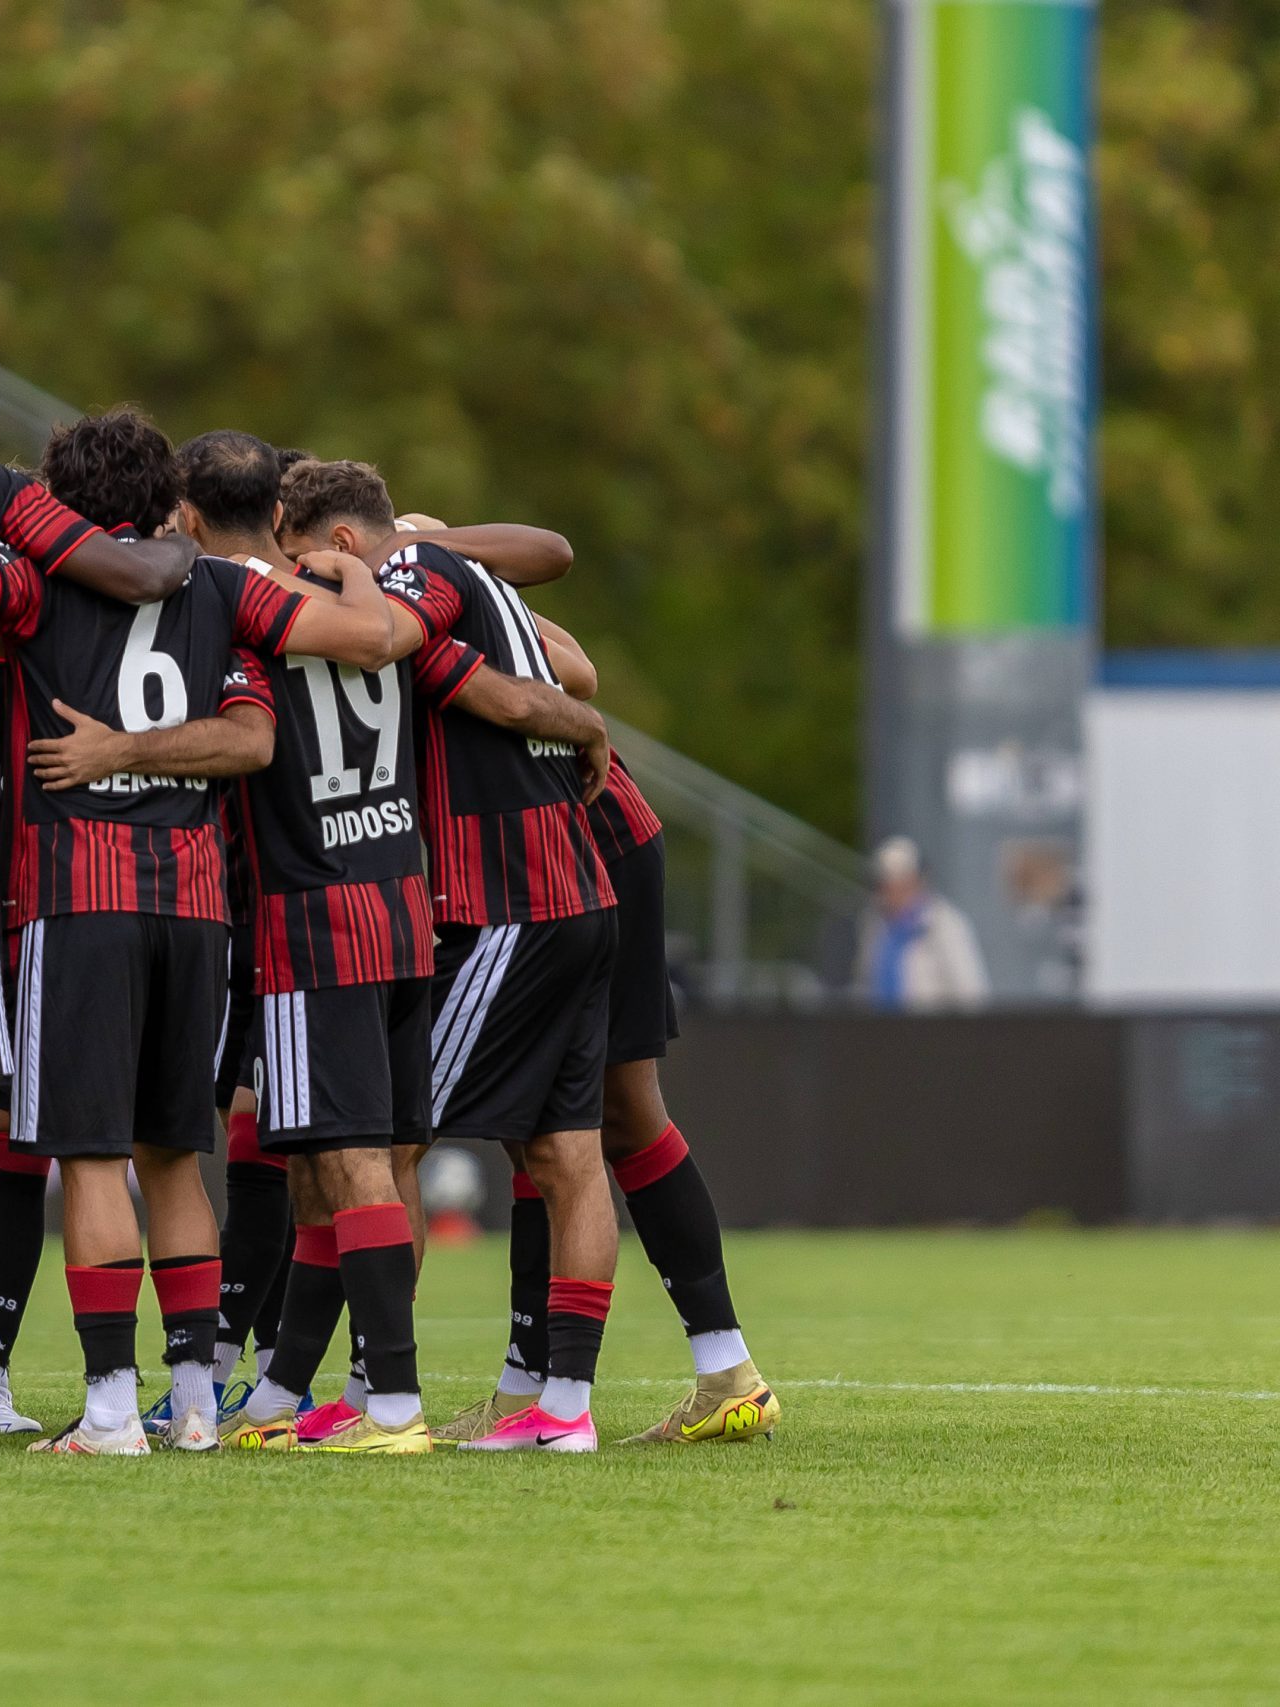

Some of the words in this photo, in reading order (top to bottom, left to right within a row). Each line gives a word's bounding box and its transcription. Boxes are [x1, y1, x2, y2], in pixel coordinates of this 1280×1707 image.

[118, 600, 188, 734] 6
[285, 654, 401, 803] 19
[321, 797, 413, 849] DIDOSS
